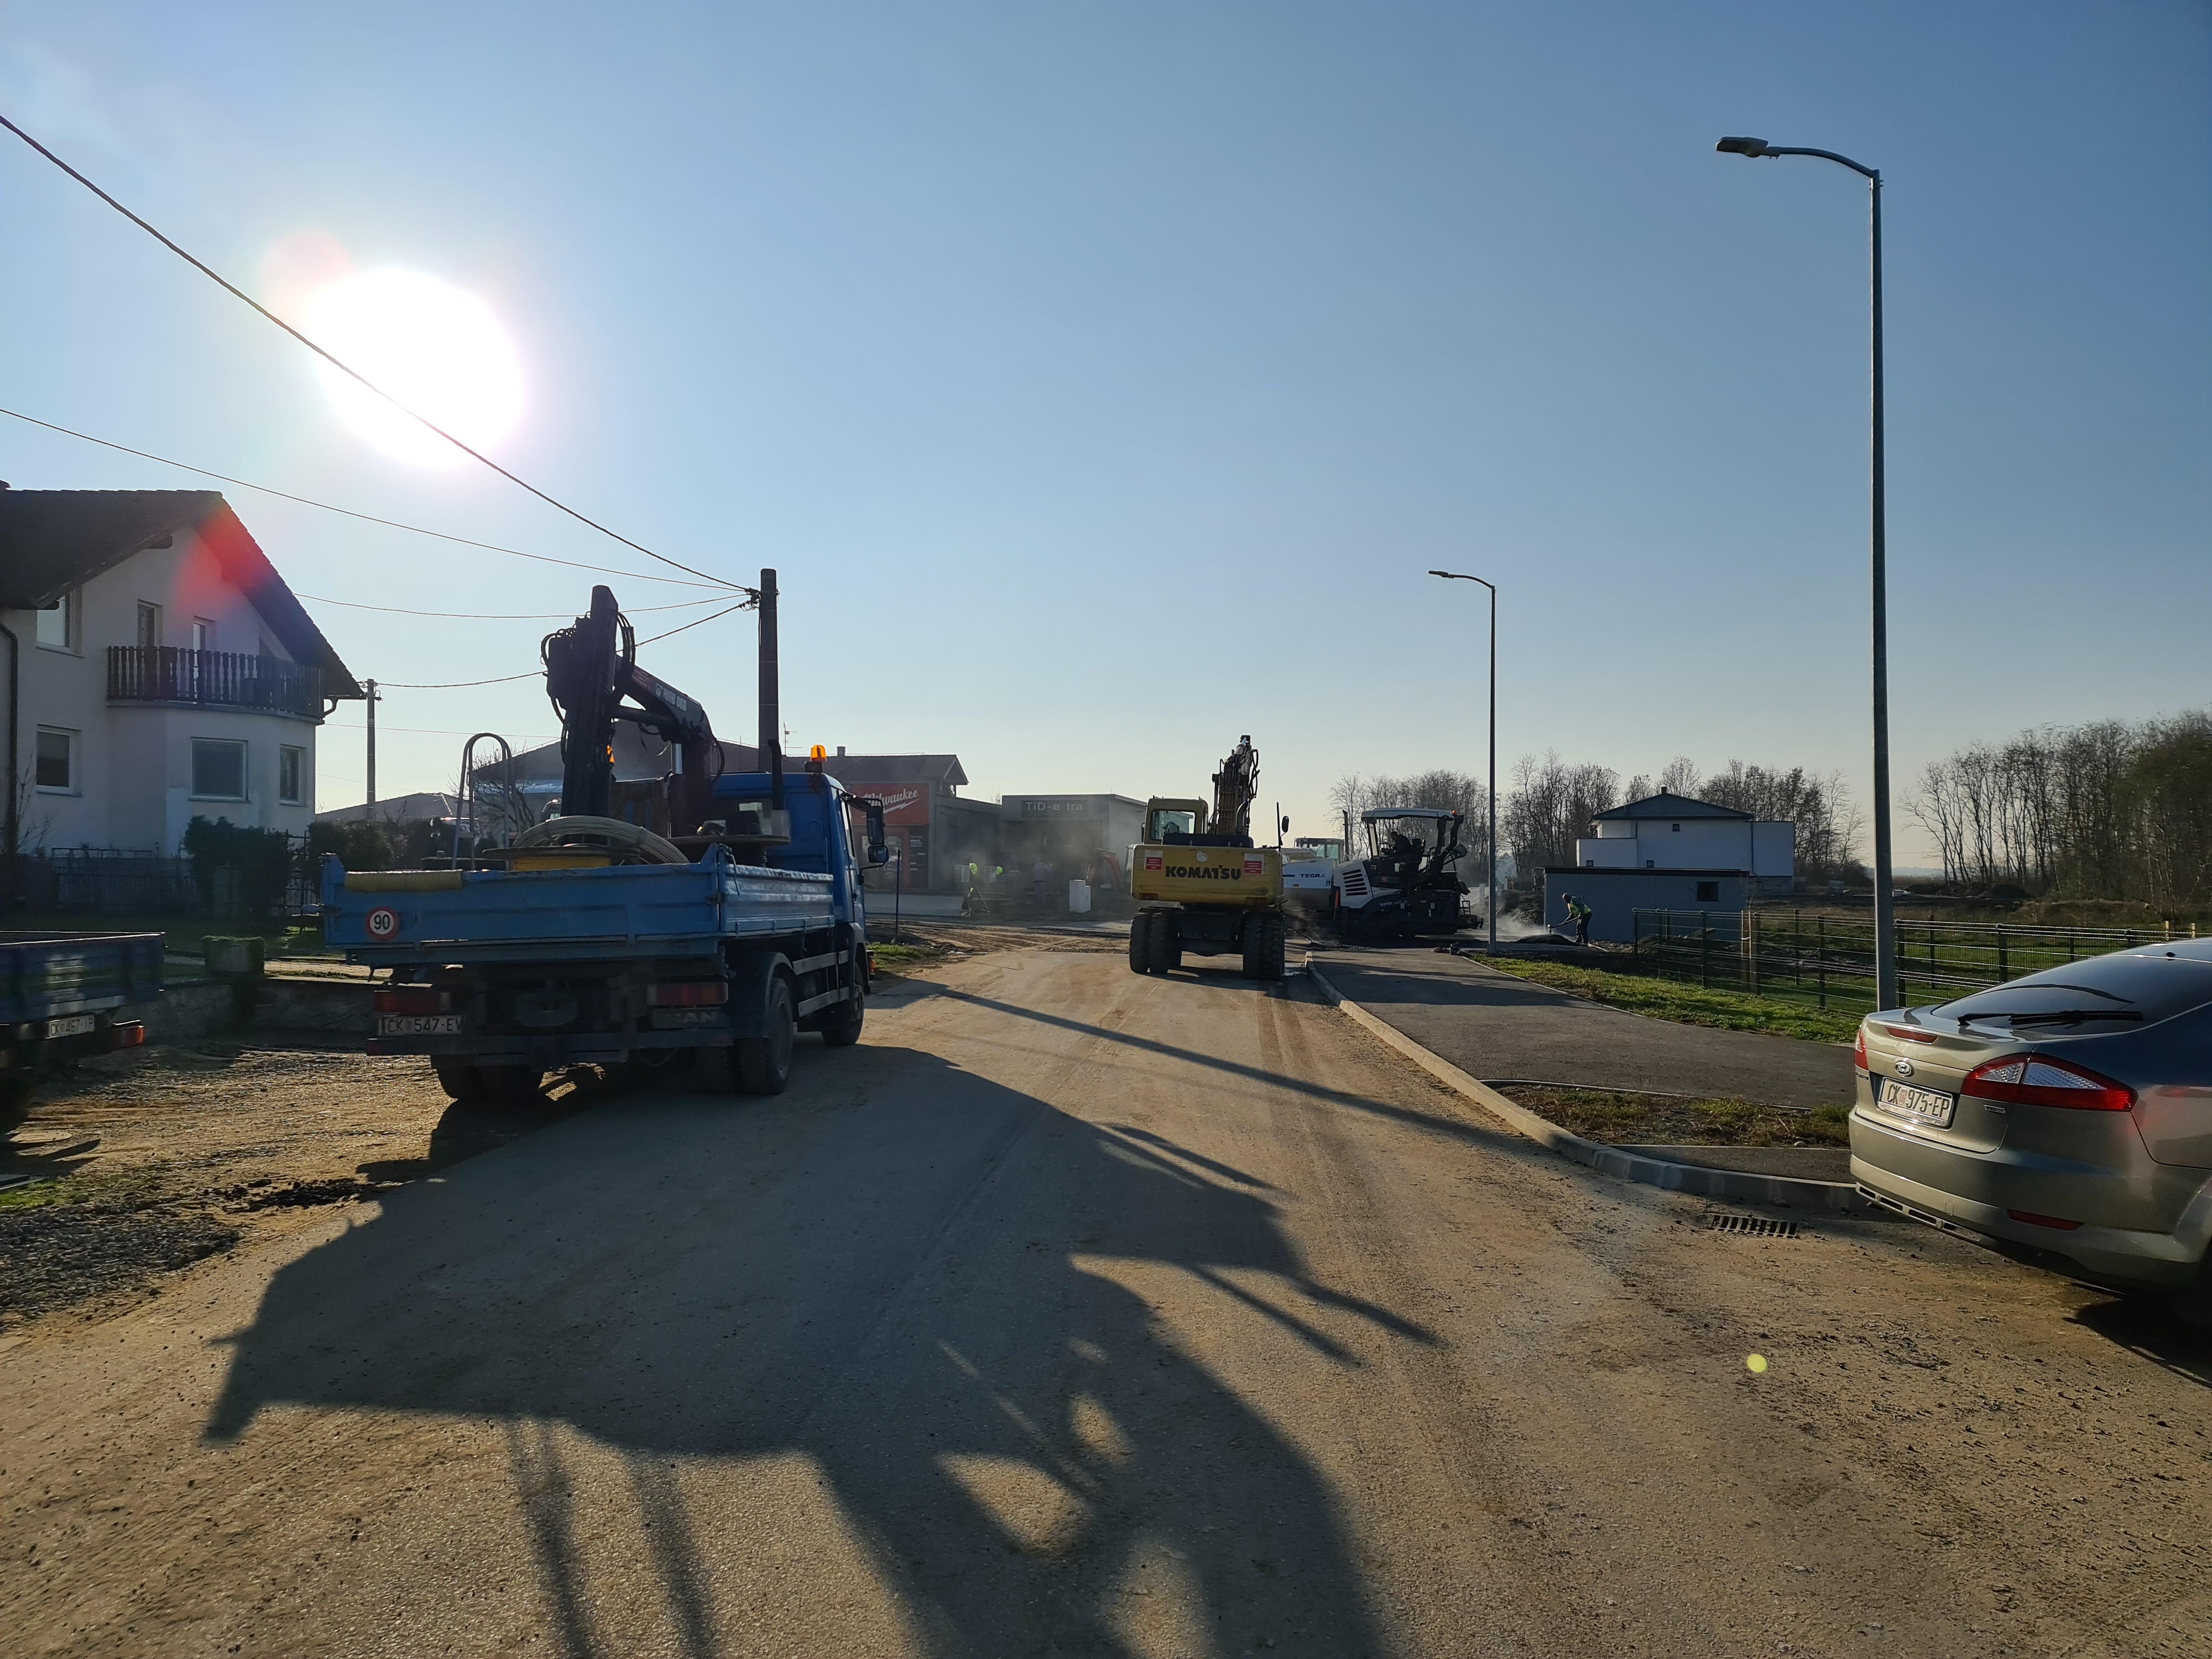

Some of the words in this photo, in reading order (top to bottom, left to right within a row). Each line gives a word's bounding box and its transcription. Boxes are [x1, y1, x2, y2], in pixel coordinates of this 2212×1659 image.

[862, 789, 919, 807] Milwaukee
[1165, 865, 1241, 880] KOMATSU
[374, 914, 390, 931] 90
[388, 1019, 403, 1032] CK
[1887, 1083, 1902, 1105] CK
[1906, 1088, 1950, 1118] 975-EP
